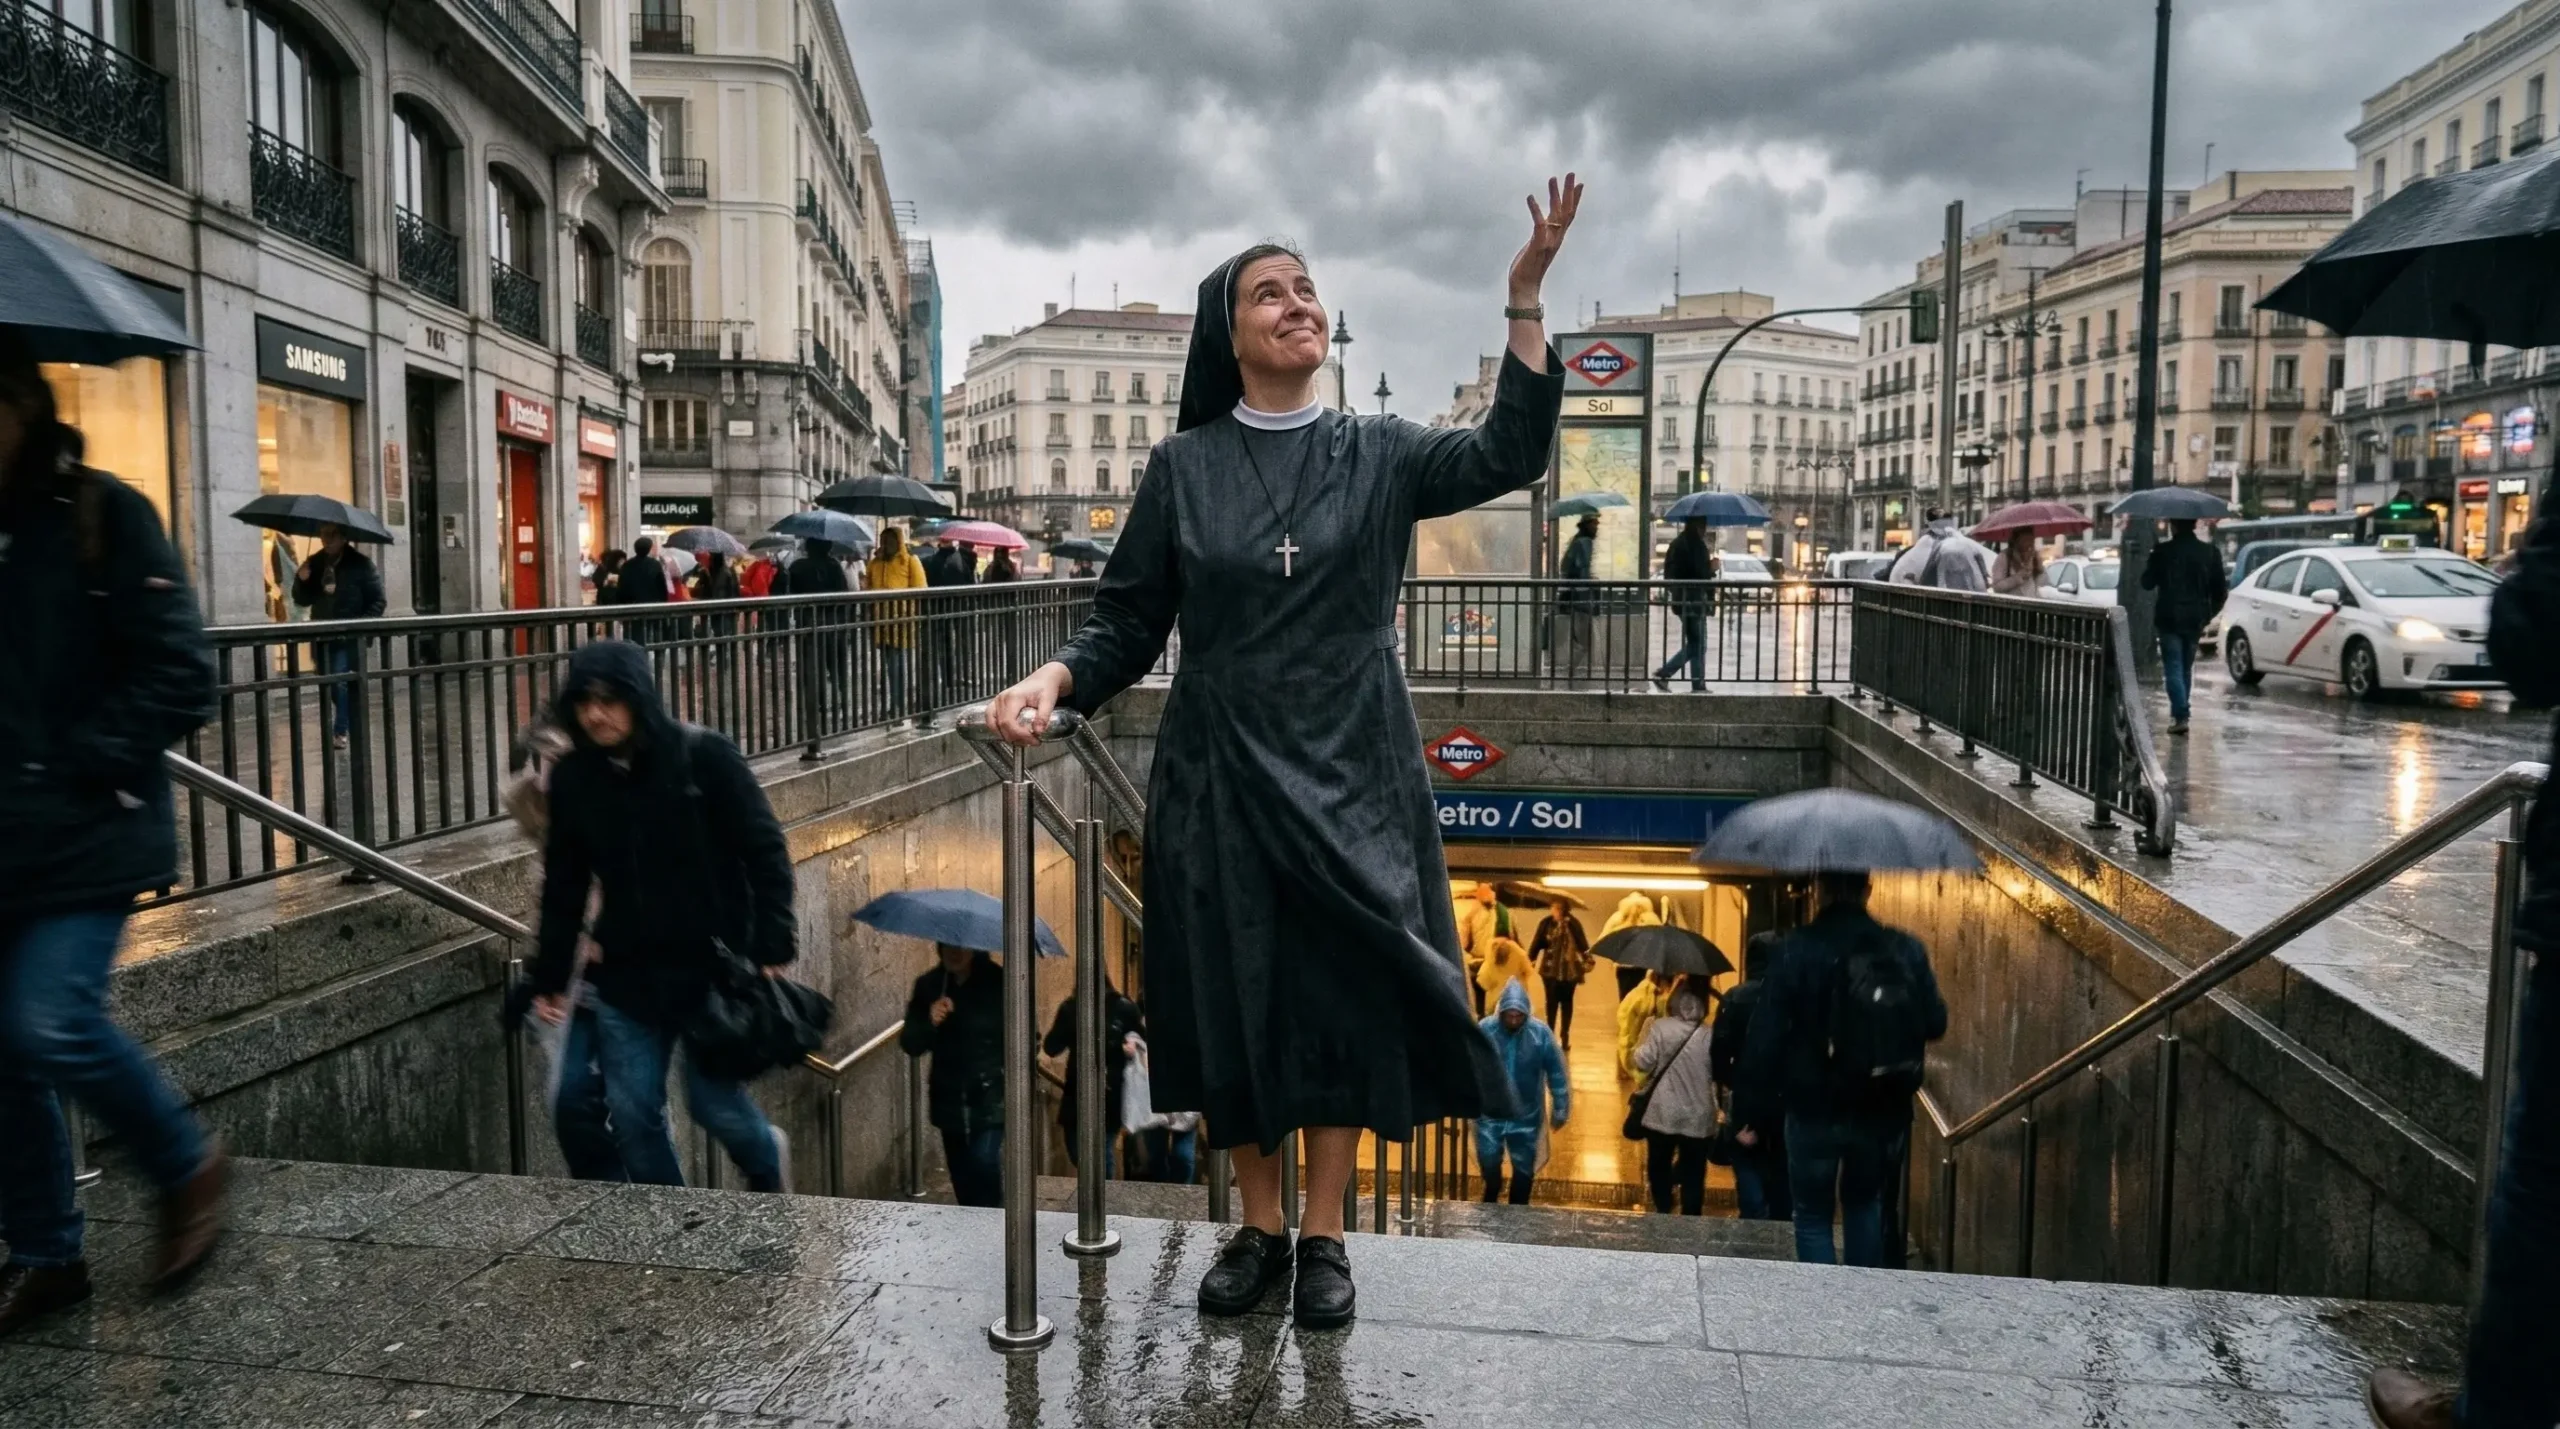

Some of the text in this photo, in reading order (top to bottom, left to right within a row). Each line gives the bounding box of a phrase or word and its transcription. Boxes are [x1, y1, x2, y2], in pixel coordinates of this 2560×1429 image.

[285, 343, 347, 382] SAMSUNG
[1582, 357, 1621, 370] Metro
[1588, 399, 1613, 412] Sol
[1442, 746, 1483, 760] Metro
[1433, 800, 1582, 829] etro / Sol
